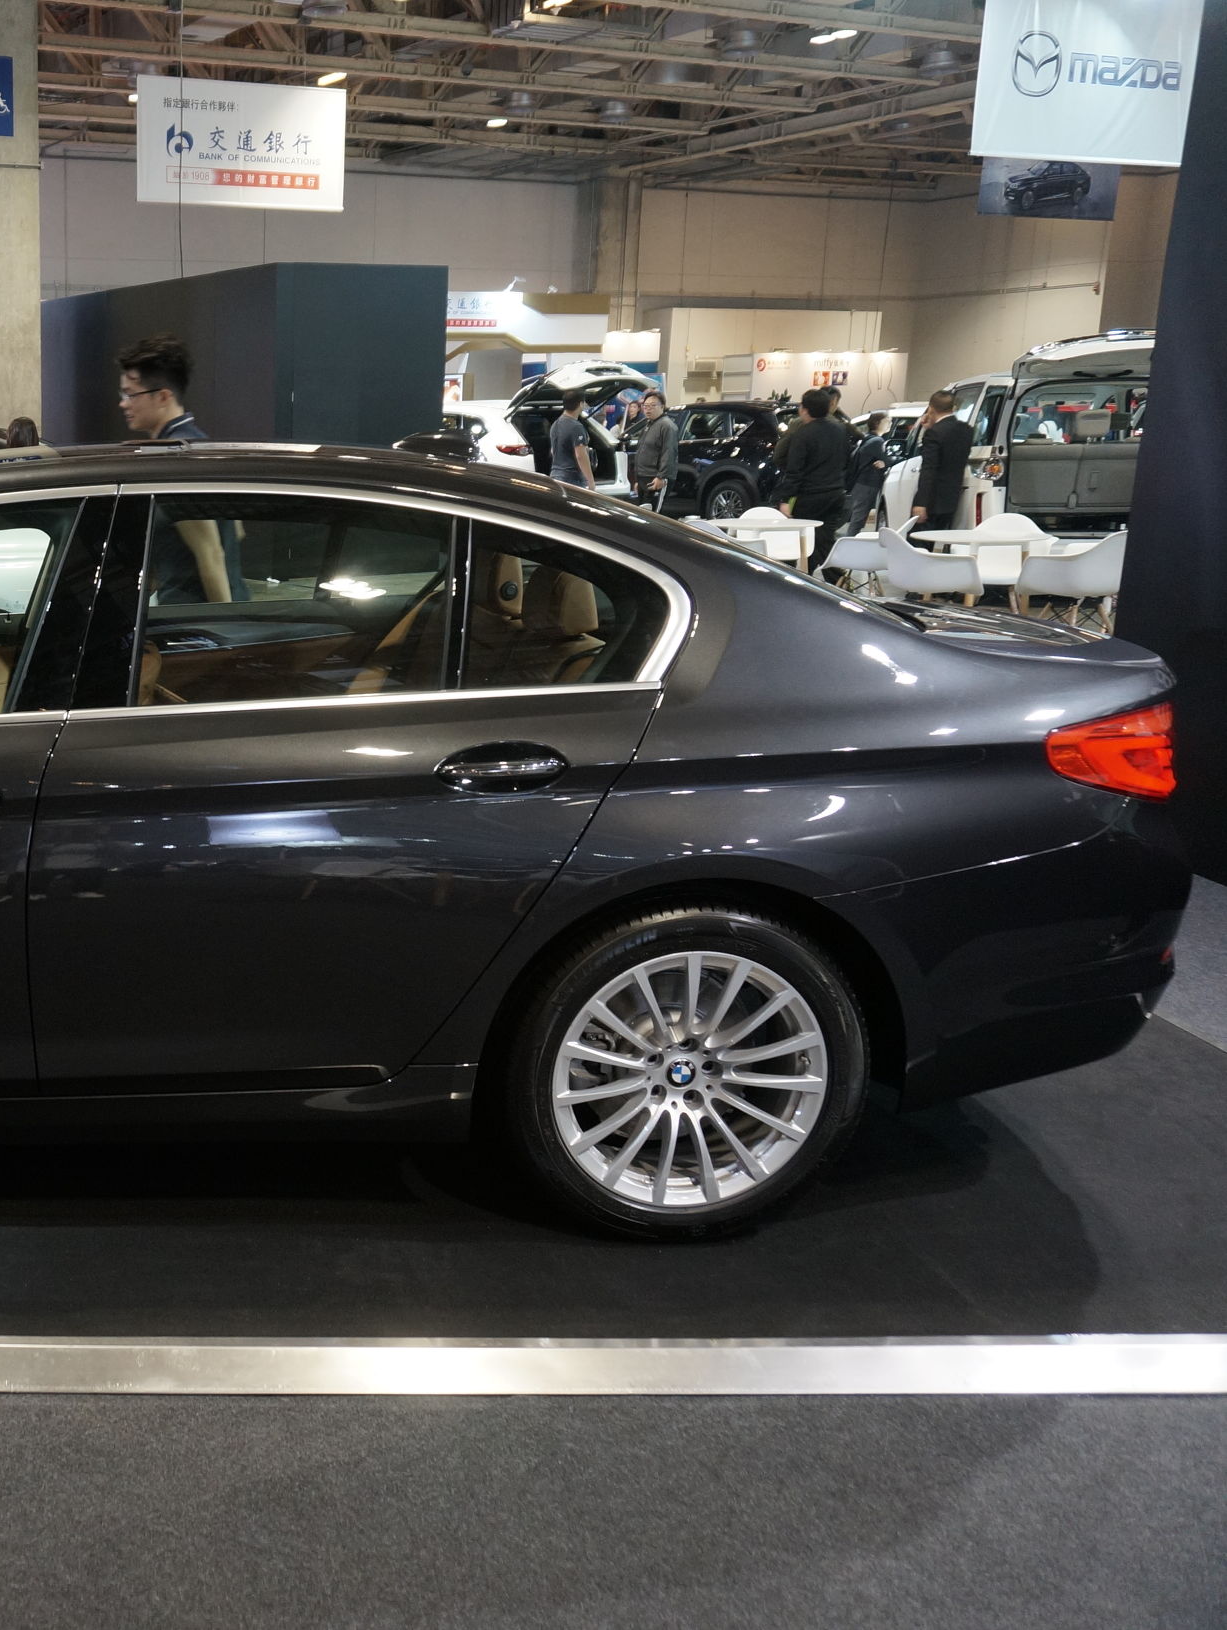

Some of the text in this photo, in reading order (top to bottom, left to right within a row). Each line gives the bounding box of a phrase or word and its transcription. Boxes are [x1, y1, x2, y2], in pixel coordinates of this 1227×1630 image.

[208, 126, 313, 155] 交通銀行
[198, 152, 223, 161] BANK
[243, 155, 321, 166] COMMUNICATIONS
[192, 172, 210, 181] 1908
